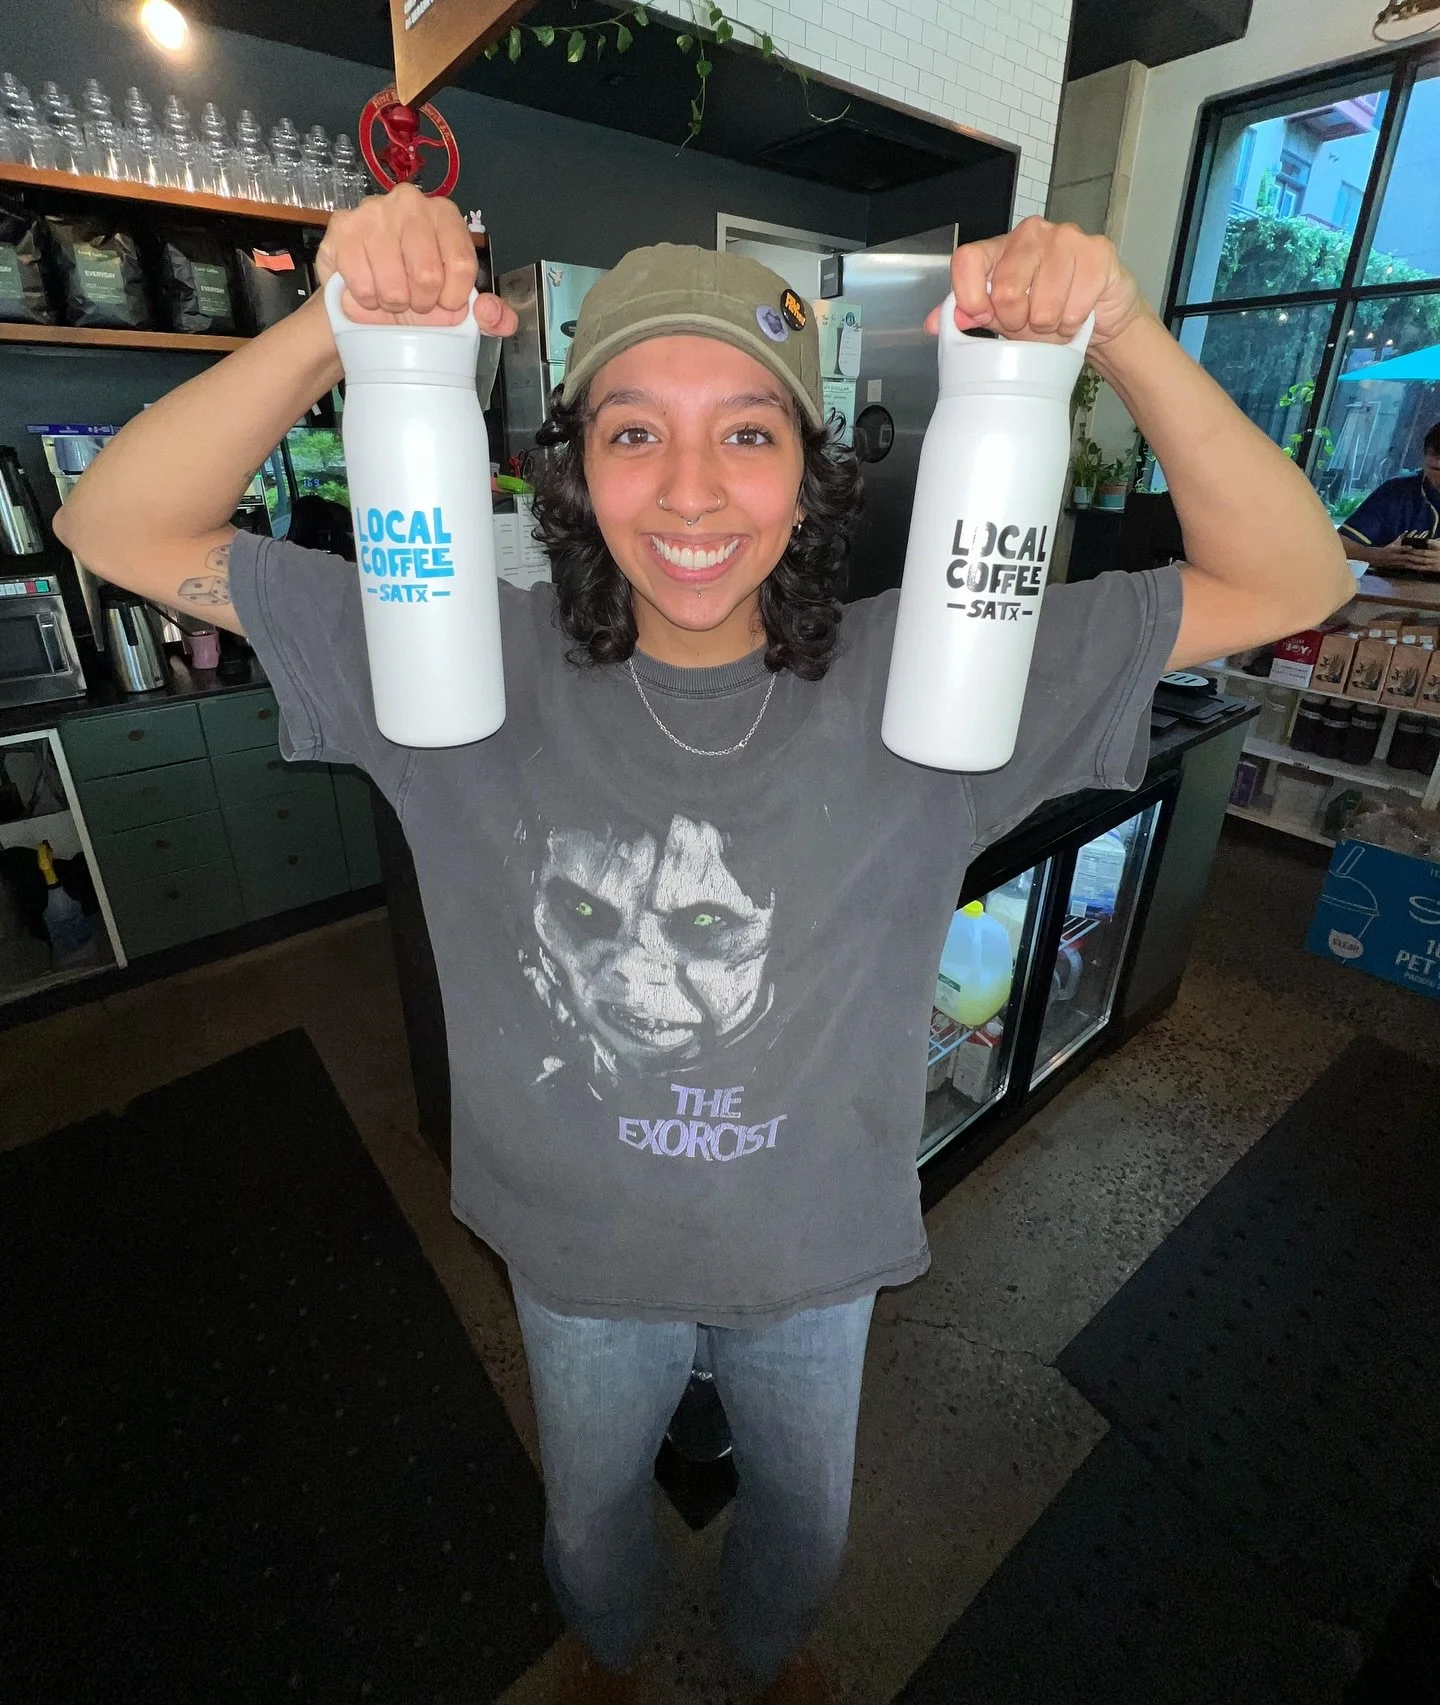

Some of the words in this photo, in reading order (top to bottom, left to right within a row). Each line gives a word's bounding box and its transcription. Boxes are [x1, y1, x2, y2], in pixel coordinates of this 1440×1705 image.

[356, 507, 452, 544] LOCAL
[951, 519, 1047, 562] LOCAL
[361, 545, 454, 578] COFFEE
[946, 558, 1042, 596] COFFEE
[1395, 949, 1436, 975] PET
[670, 1083, 745, 1118] THE
[618, 1113, 788, 1162] EXORCIST
